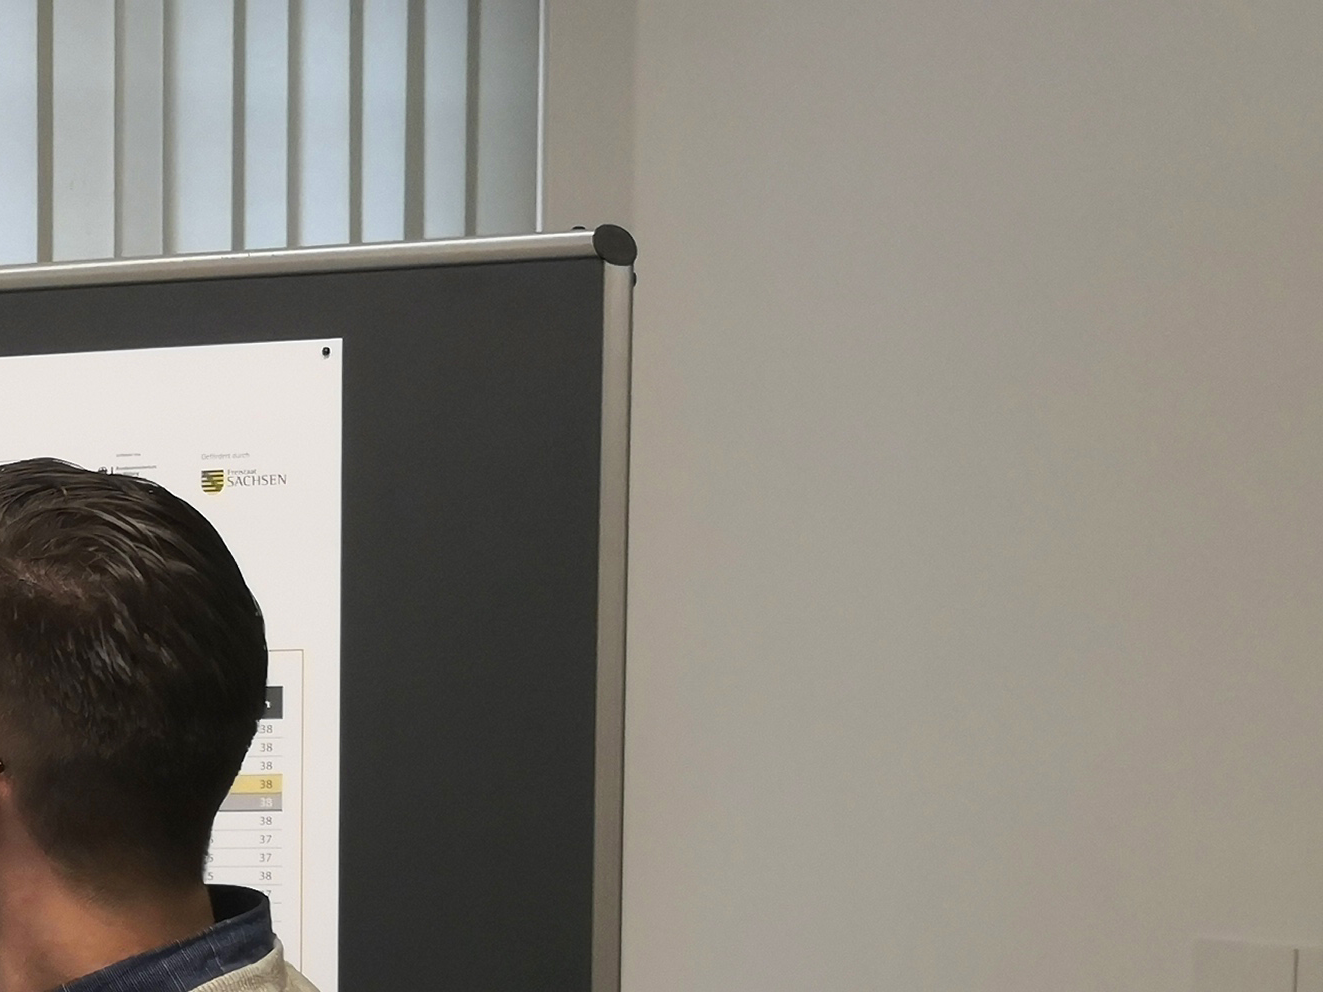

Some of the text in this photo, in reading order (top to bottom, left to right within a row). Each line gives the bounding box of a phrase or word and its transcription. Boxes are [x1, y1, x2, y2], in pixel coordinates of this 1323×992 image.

[227, 474, 287, 487] SACHSEN
[260, 744, 273, 752] 38
[260, 762, 273, 770] 38
[260, 780, 273, 789] 38
[260, 817, 272, 825] 38
[259, 835, 272, 844] 37
[259, 854, 272, 862] 37
[259, 872, 272, 880] 38
